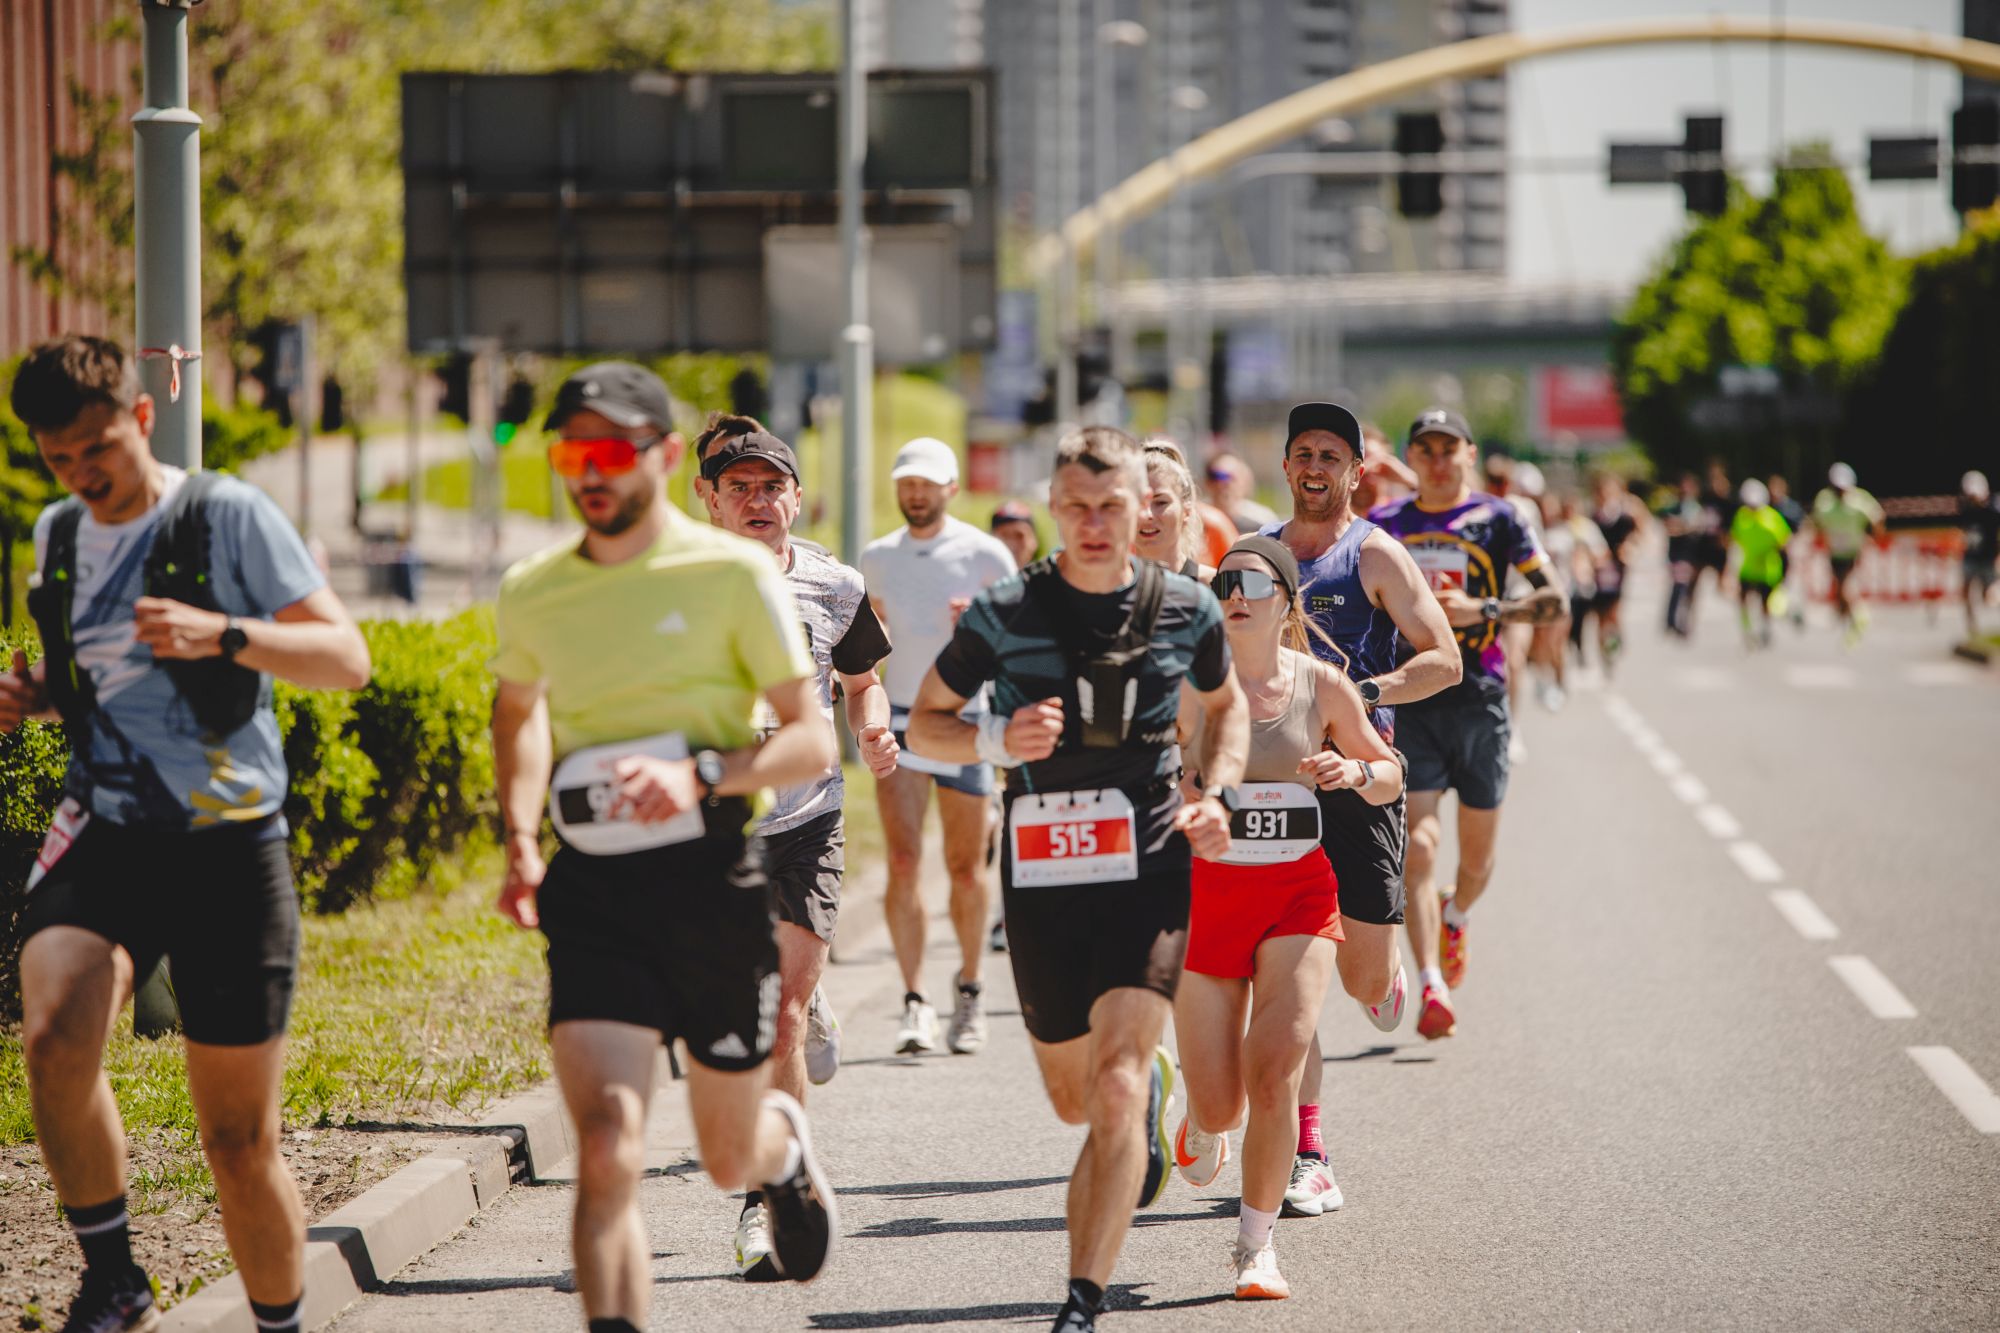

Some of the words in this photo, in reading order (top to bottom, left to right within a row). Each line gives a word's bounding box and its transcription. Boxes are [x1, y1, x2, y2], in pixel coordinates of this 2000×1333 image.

[1333, 594, 1345, 606] 10
[1246, 811, 1288, 838] 931
[1049, 822, 1098, 857] 515
